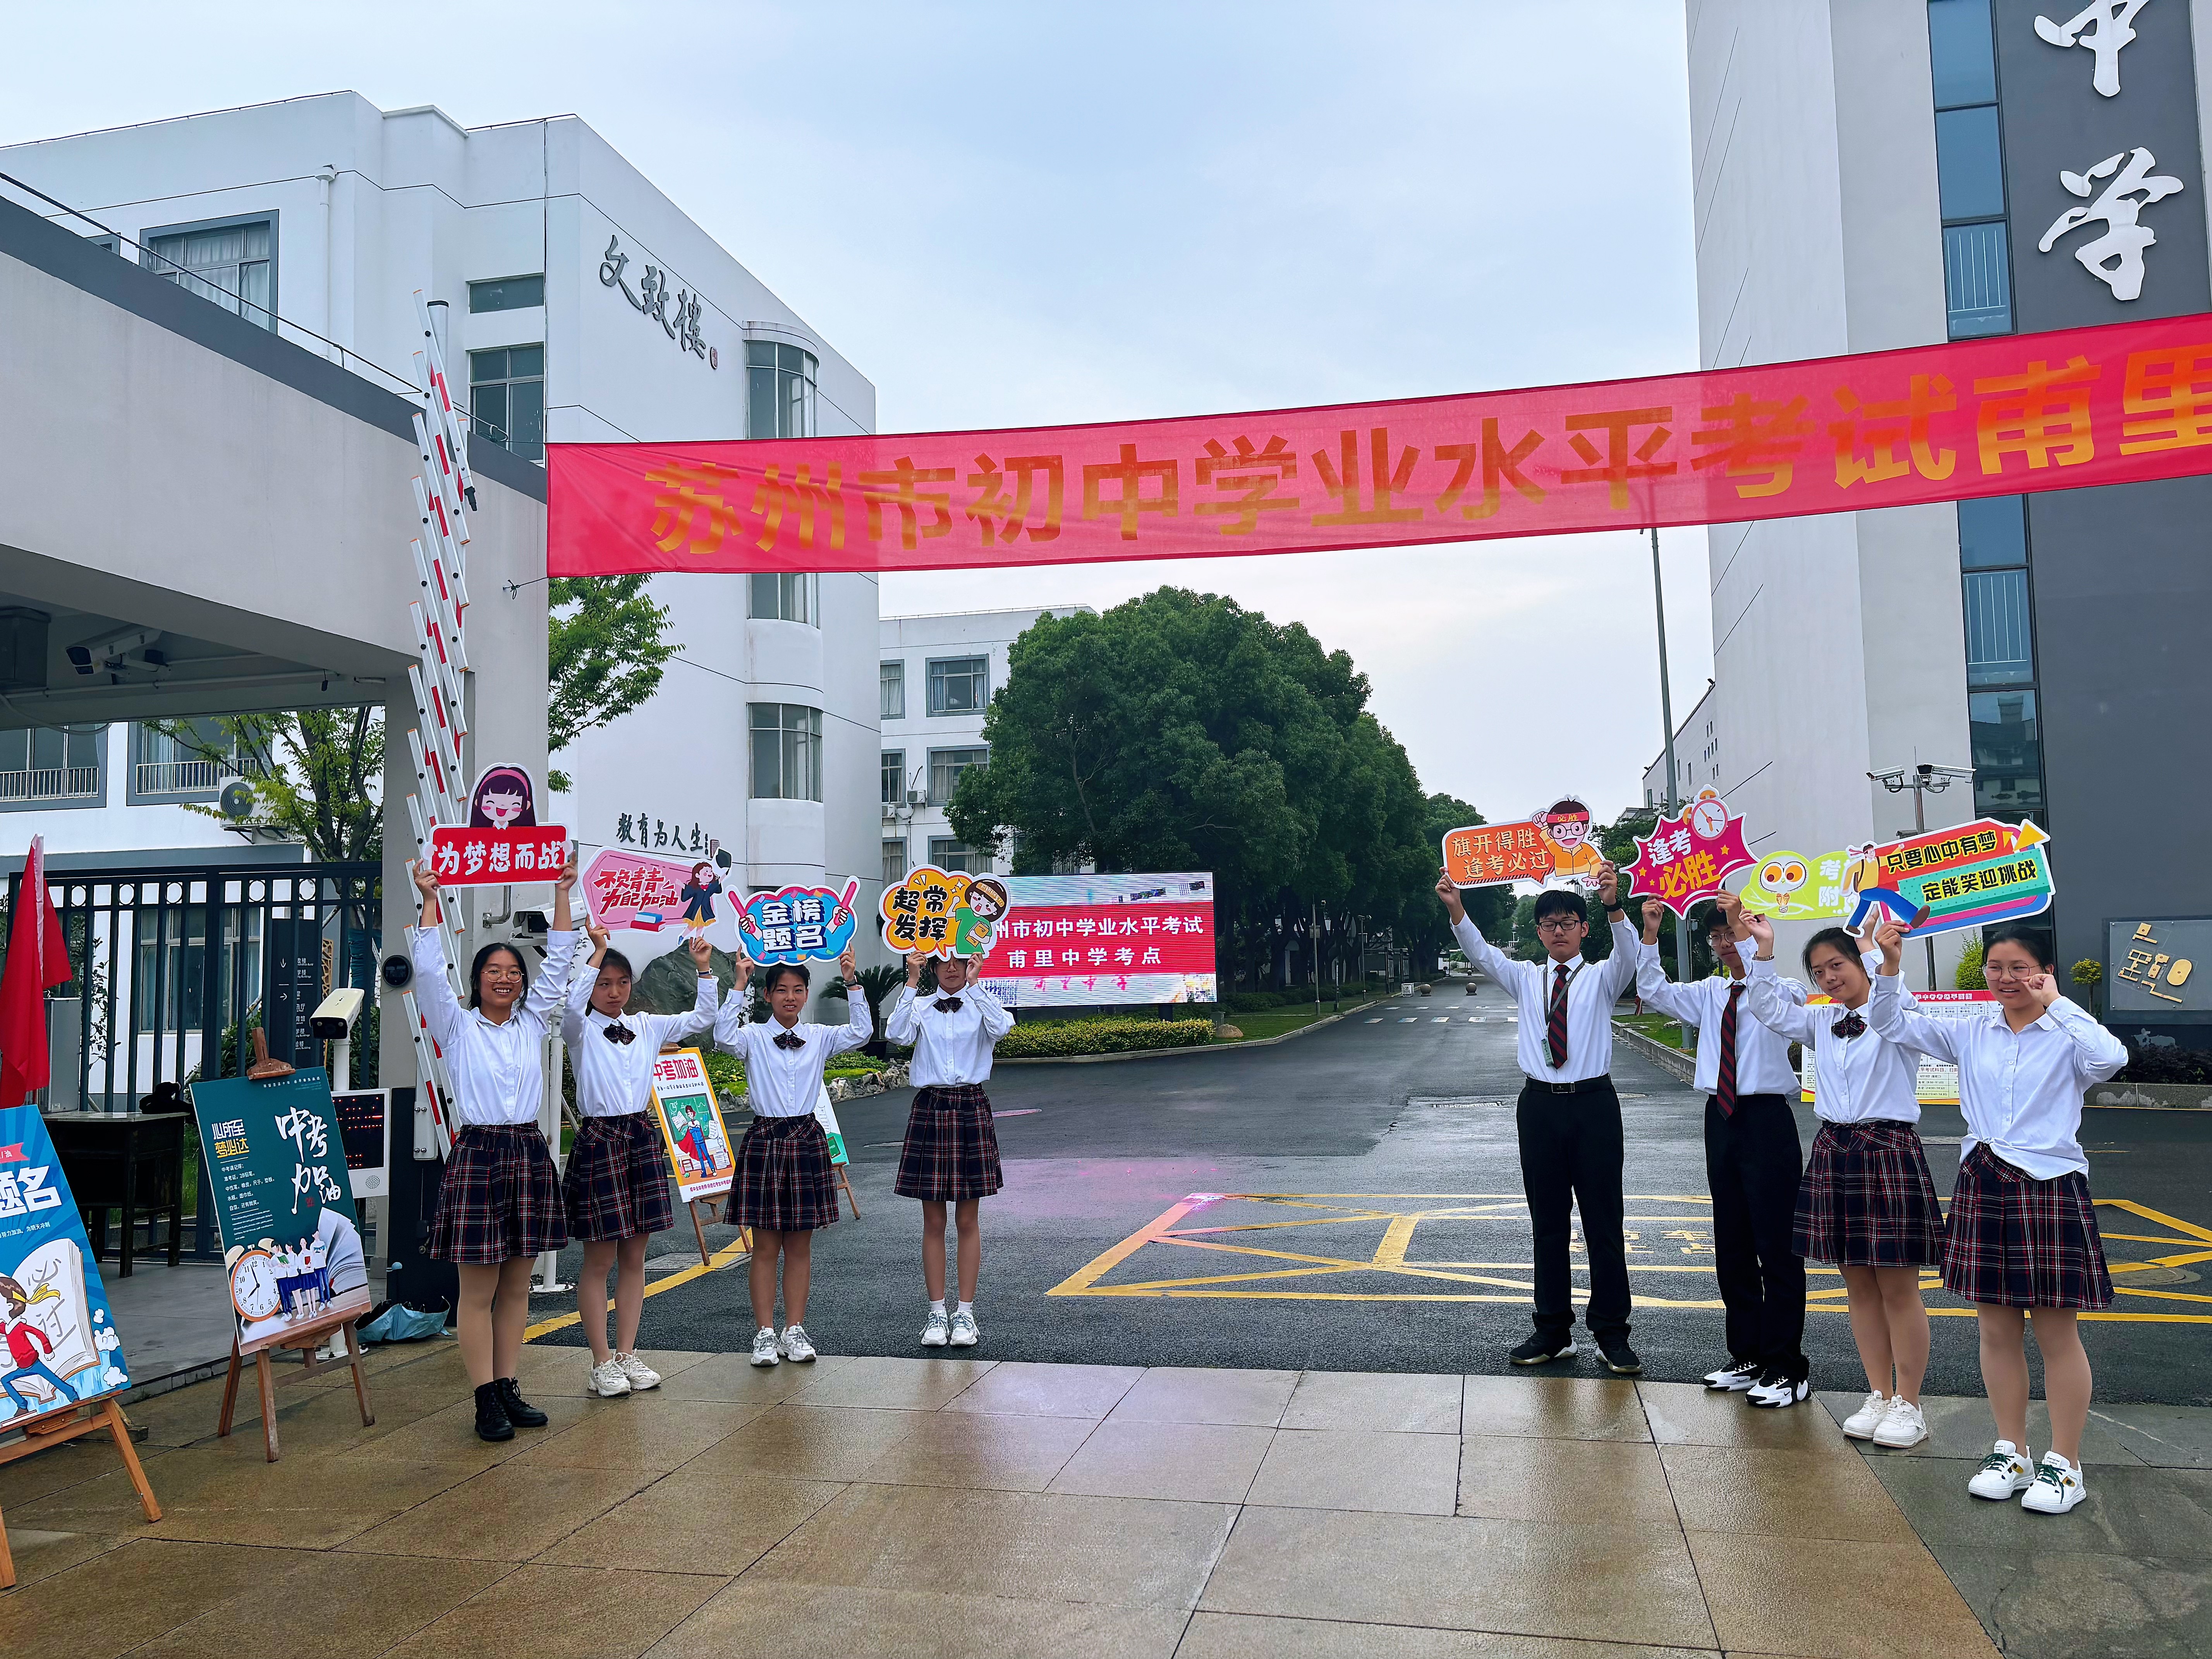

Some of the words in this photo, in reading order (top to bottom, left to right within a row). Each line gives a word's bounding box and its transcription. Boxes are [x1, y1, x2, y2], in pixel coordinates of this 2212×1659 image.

[644, 342, 2212, 555] 苏州市初中学业水平考试甫里
[1557, 814, 1579, 822] 必胜
[1451, 828, 1537, 857] 旗开得胜
[1647, 828, 1691, 868] 逢考
[1886, 830, 1997, 874] 只要心中有梦
[438, 840, 561, 876] 为梦想而战
[1463, 848, 1549, 879] 逢考必过
[1819, 859, 1851, 881] 考
[1659, 849, 1721, 900] 必胜
[1921, 859, 2037, 903] 定能笑迎挑战
[599, 887, 679, 916] 为自己加油
[761, 898, 824, 927] 金榜
[892, 884, 948, 914] 超常
[762, 924, 826, 953] 题名
[894, 913, 948, 941] 发挥
[1006, 946, 1161, 969] 甫里中学考点
[653, 1058, 699, 1081] 中考加油
[211, 1119, 246, 1140] 心所至
[275, 1106, 328, 1163] 中考
[214, 1137, 250, 1158] 梦必达
[291, 1163, 341, 1214] 加油
